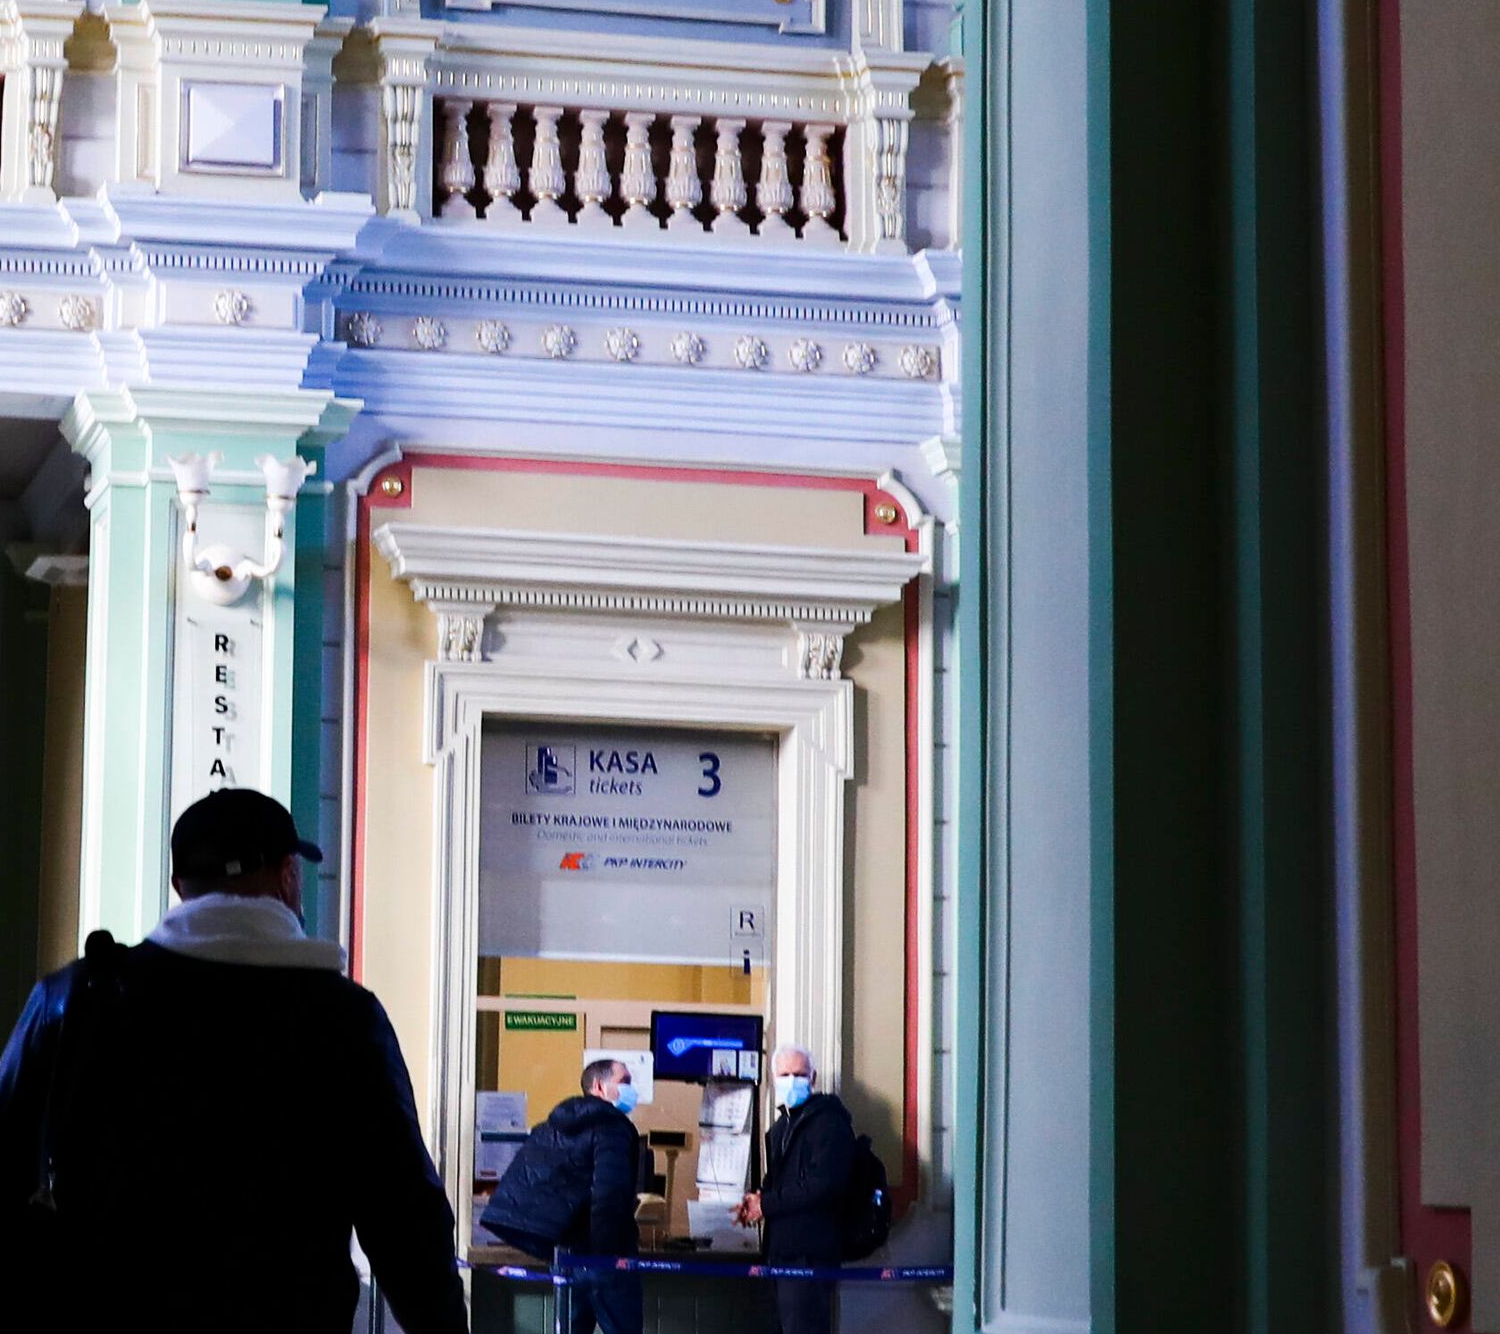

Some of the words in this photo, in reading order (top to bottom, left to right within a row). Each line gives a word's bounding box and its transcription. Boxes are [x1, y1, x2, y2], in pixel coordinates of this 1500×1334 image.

[209, 633, 230, 796] RESTA
[589, 749, 658, 775] KASA
[697, 751, 722, 798] 3
[589, 776, 643, 796] tickets
[511, 812, 551, 826] BILETY
[553, 814, 610, 829] KRAJOWE
[619, 816, 733, 834] MIĘDZYNARODOWE
[603, 855, 629, 868] PKP
[630, 857, 687, 870] INTERCITY
[739, 910, 755, 930] R
[507, 1014, 575, 1027] EWAKUACYJNE
